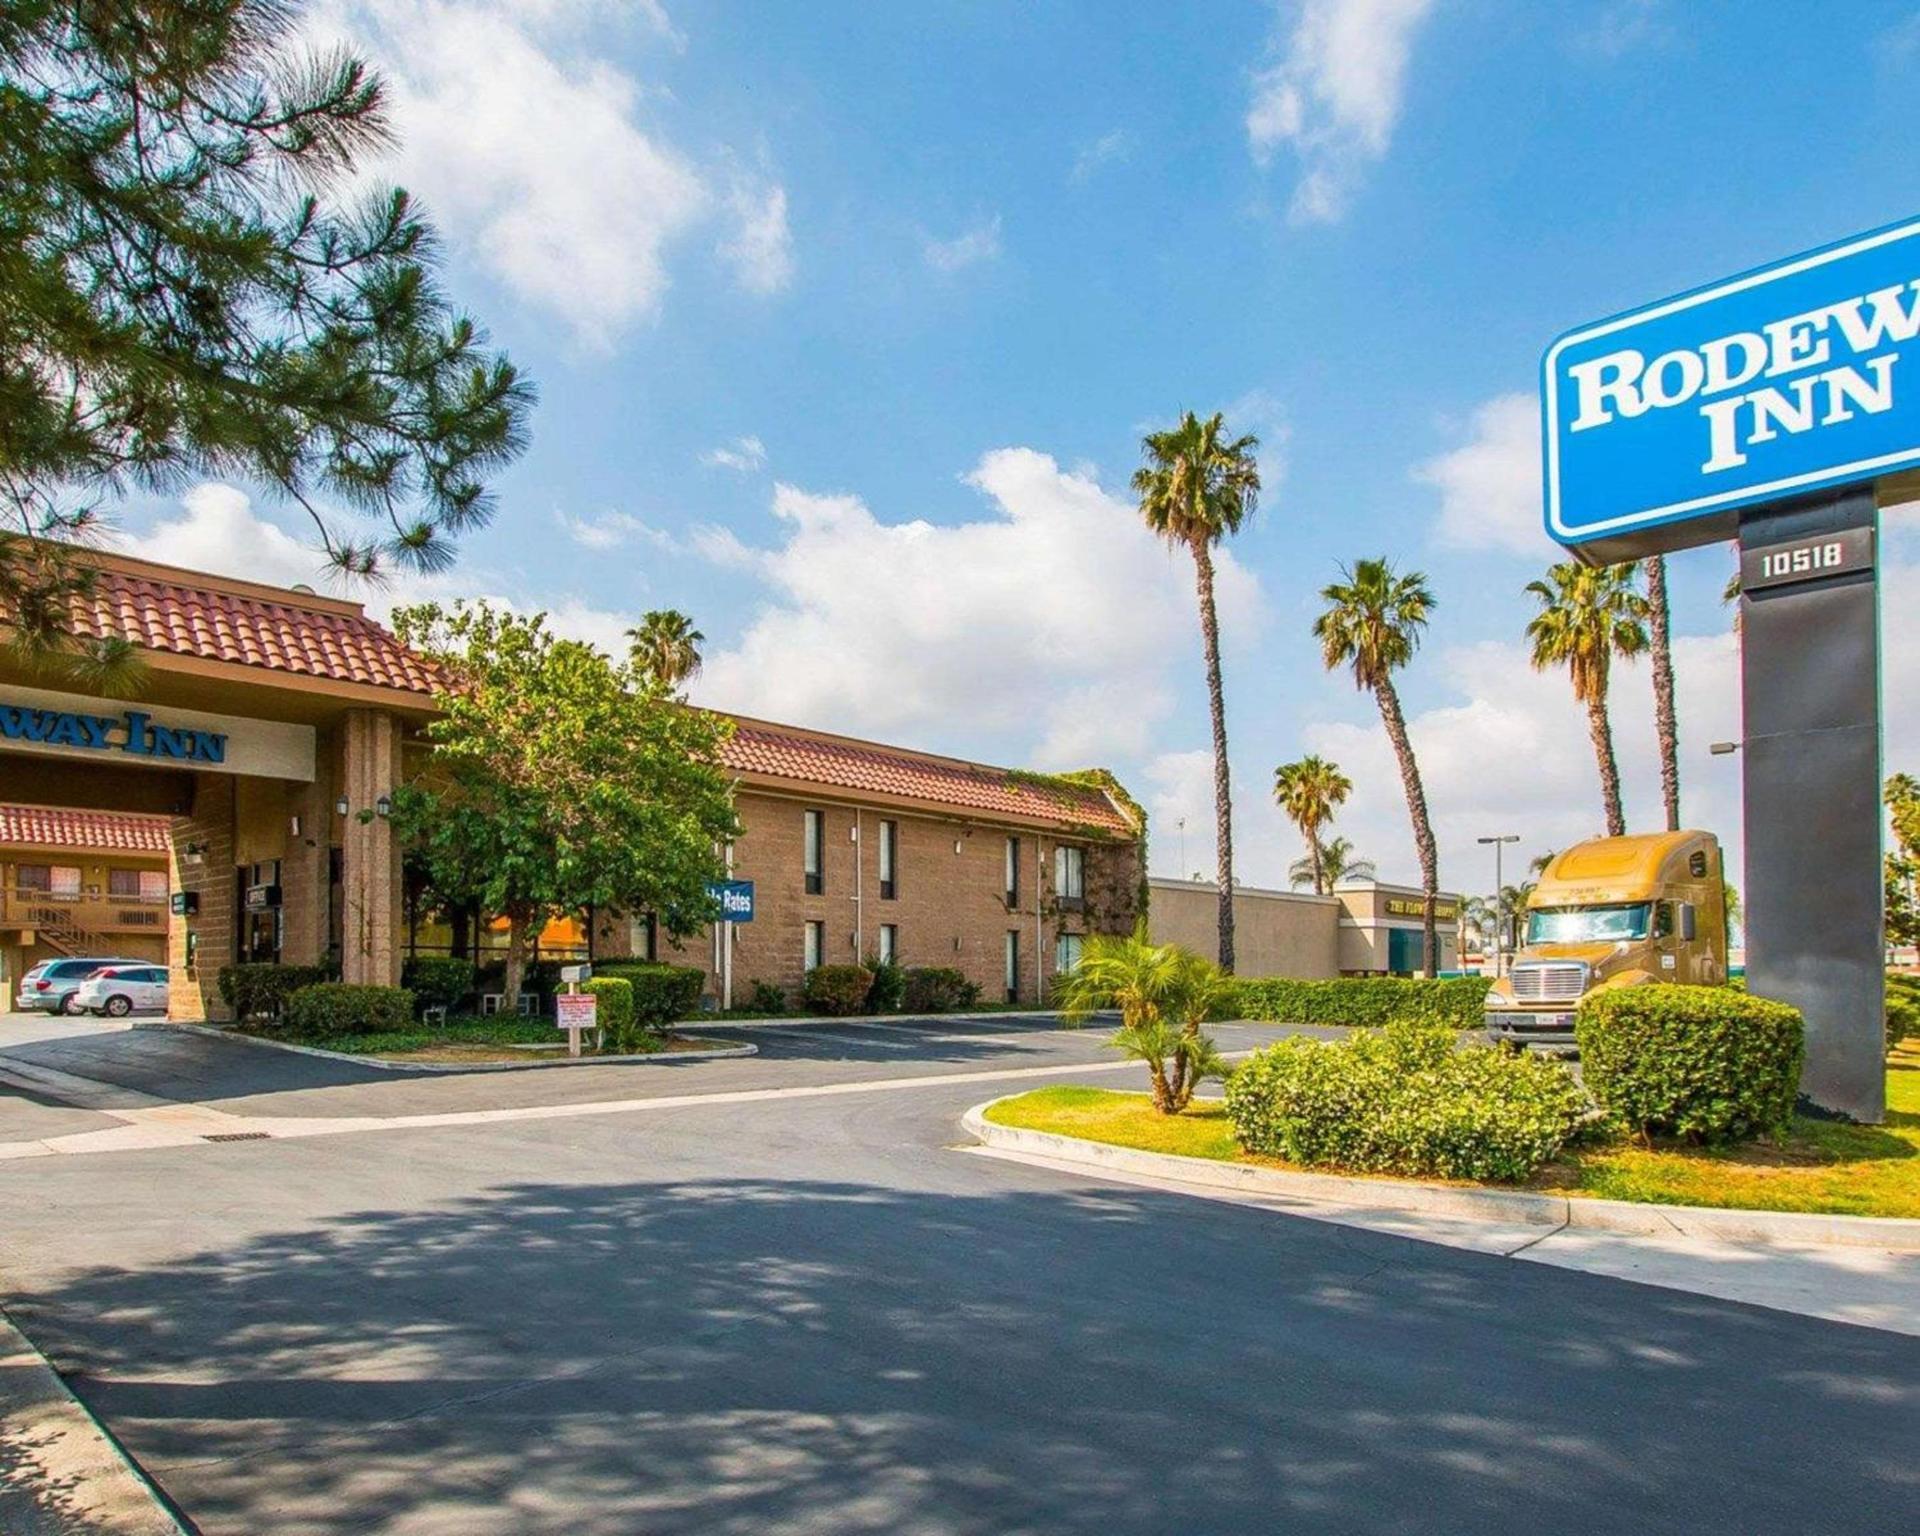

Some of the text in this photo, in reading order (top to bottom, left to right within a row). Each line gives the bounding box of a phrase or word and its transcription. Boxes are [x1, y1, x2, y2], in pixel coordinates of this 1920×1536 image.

[1700, 353, 1899, 474] INN
[1762, 543, 1842, 578] 10518
[123, 711, 228, 763] INN
[723, 889, 751, 912] Rates
